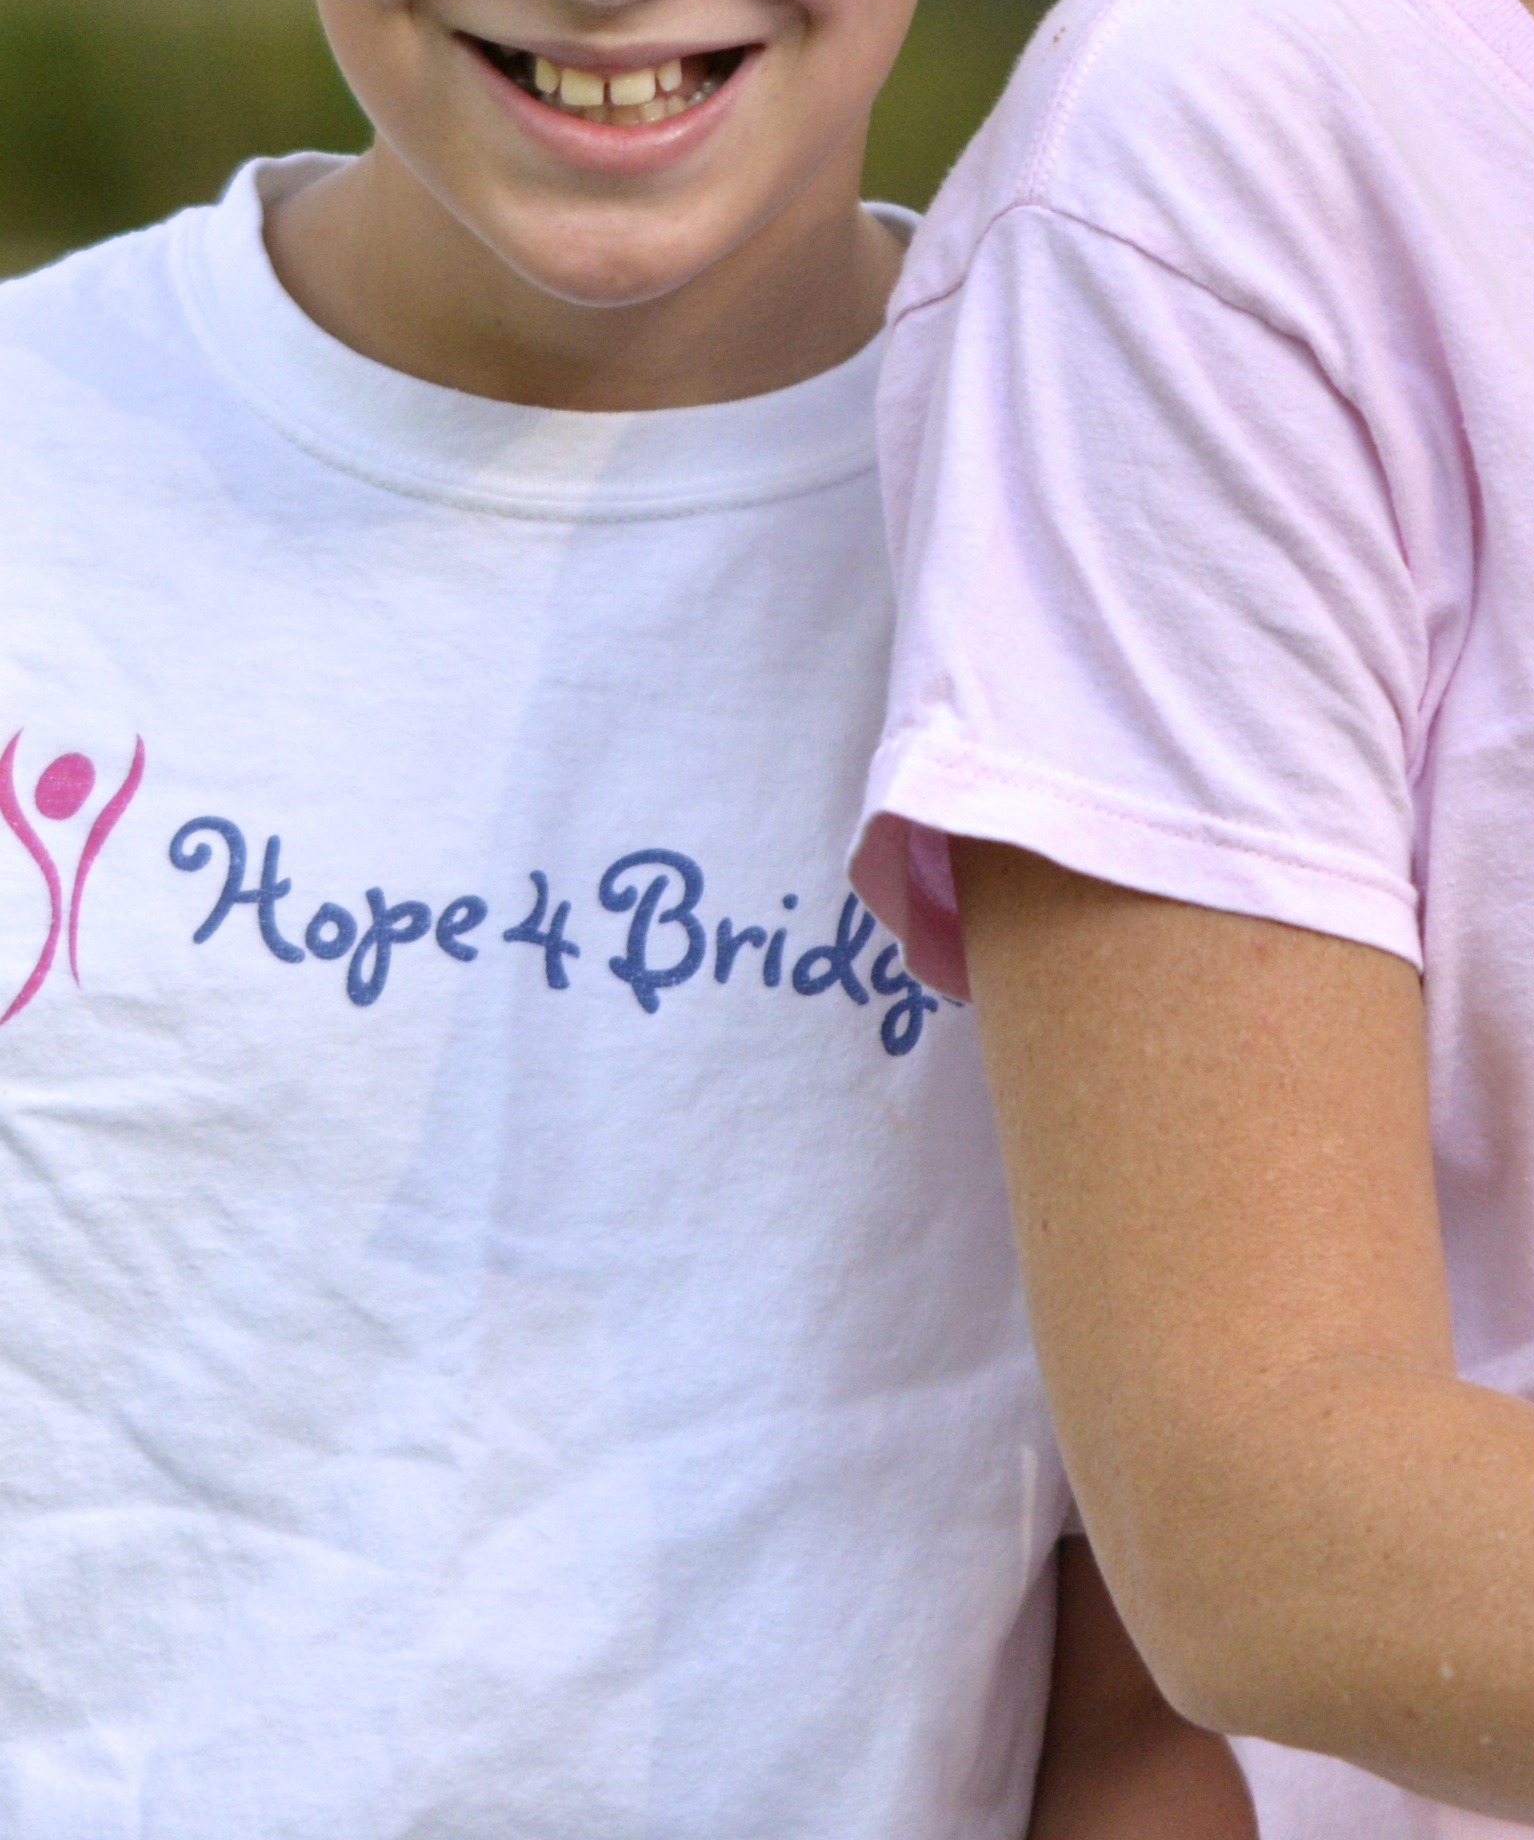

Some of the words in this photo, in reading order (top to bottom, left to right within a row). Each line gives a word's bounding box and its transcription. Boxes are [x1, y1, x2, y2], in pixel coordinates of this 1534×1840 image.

[168, 815, 489, 1007] Hope
[502, 870, 580, 990] 4
[599, 848, 965, 1057] Bridg
